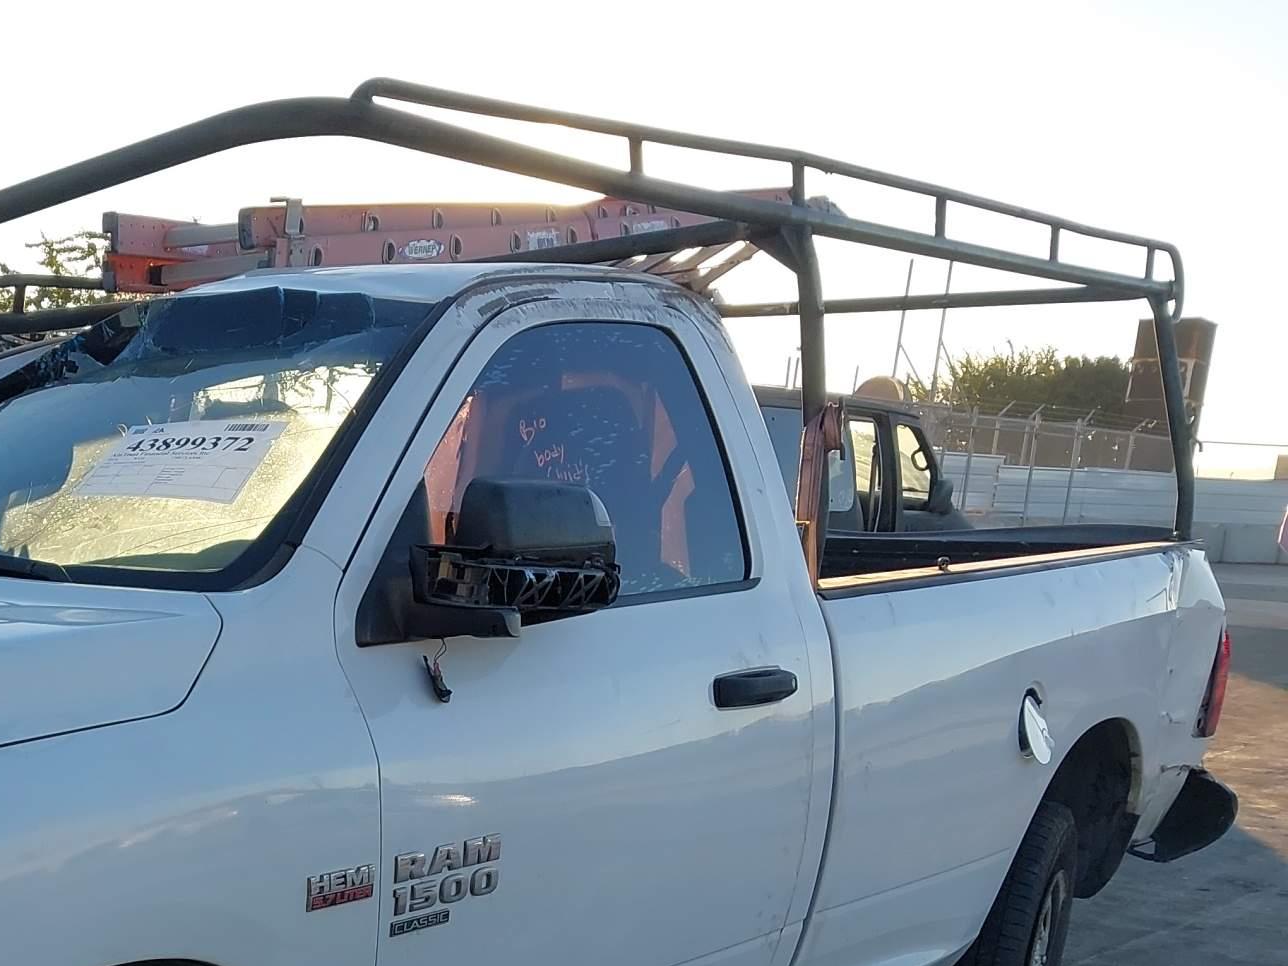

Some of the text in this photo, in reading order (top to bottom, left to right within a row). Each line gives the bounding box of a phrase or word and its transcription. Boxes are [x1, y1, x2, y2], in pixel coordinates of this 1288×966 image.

[126, 436, 255, 452] 43899372
[519, 418, 546, 446] Bio
[534, 443, 564, 467] body
[394, 833, 501, 884] RAM
[308, 864, 375, 896] HEMI
[393, 866, 499, 916] 1500
[311, 885, 372, 909] 5.7 LITER
[394, 911, 449, 935] CLASSIC
